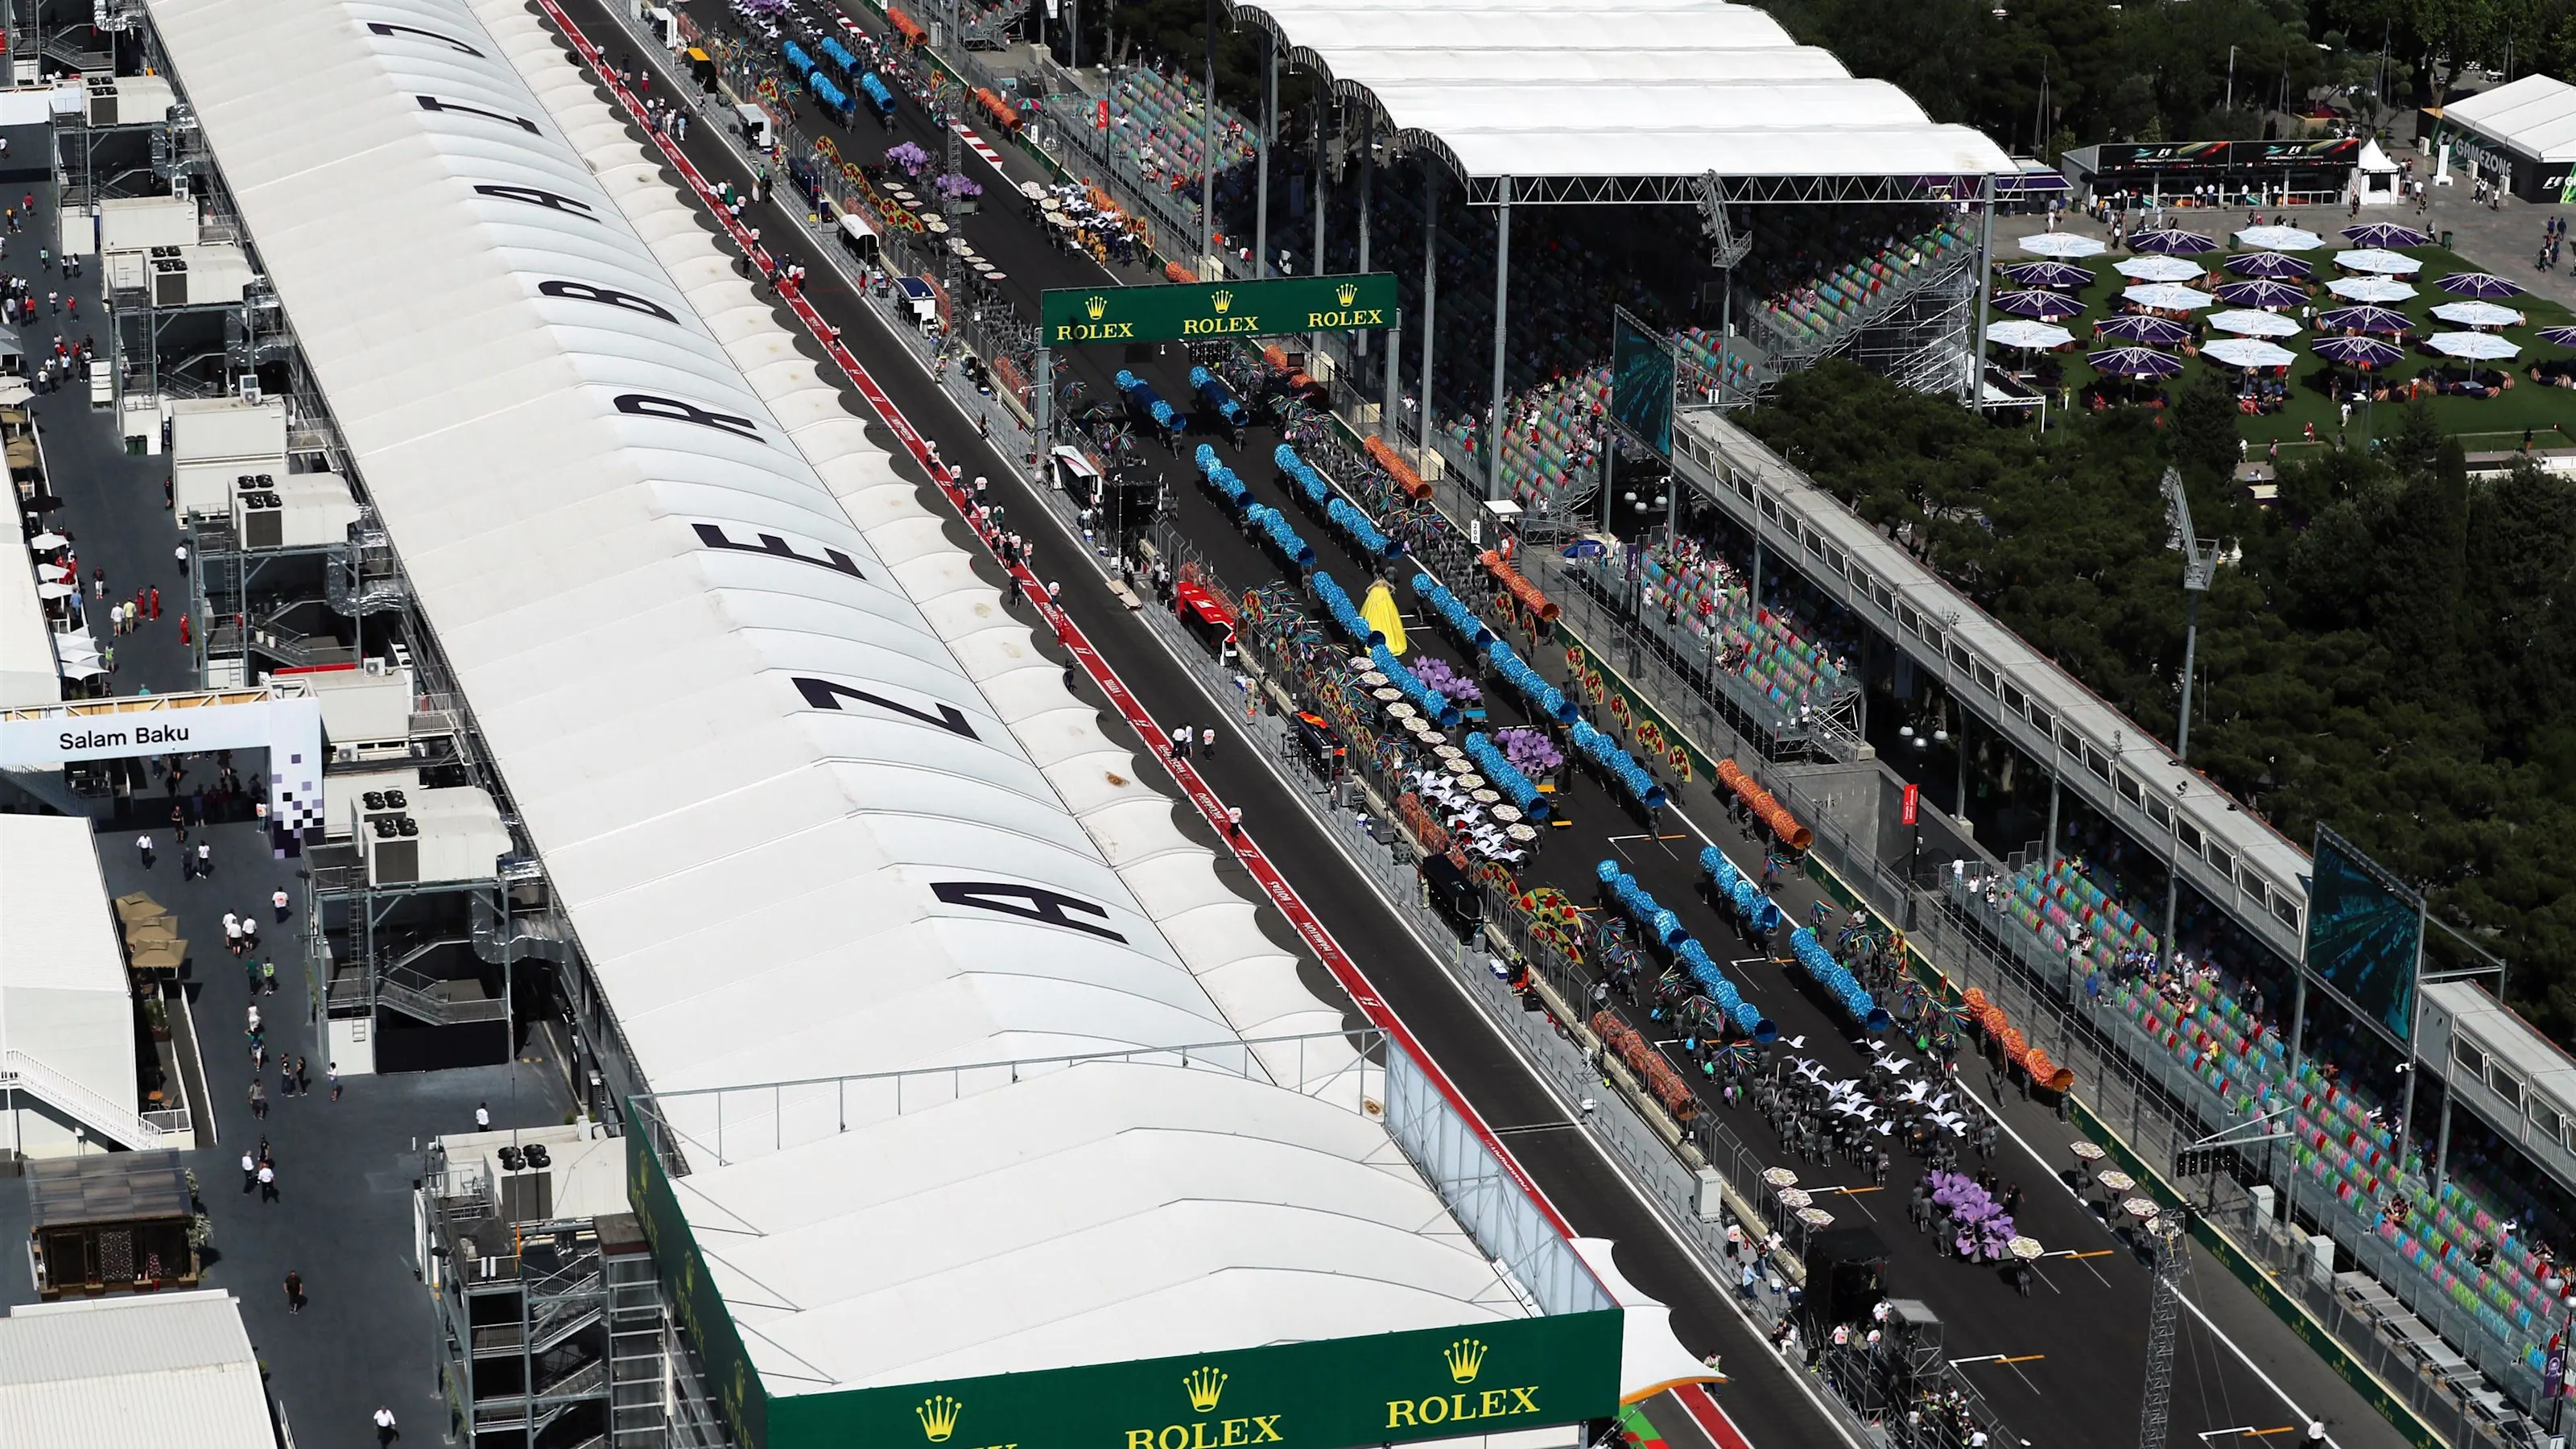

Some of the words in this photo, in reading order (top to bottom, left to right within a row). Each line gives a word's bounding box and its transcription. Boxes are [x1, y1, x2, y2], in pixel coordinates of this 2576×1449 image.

[2456, 138, 2512, 175] GAMEZONE
[1057, 323, 1133, 341] ROLEX
[1183, 316, 1259, 335] ROLEX
[1308, 309, 1383, 328] ROLEX
[60, 730, 127, 750] Salam
[135, 724, 189, 744] Baku
[1301, 921, 1333, 953] HAMILTON
[1386, 1385, 1541, 1429] ROLEX
[1125, 1414, 1284, 1449] ROLEX
